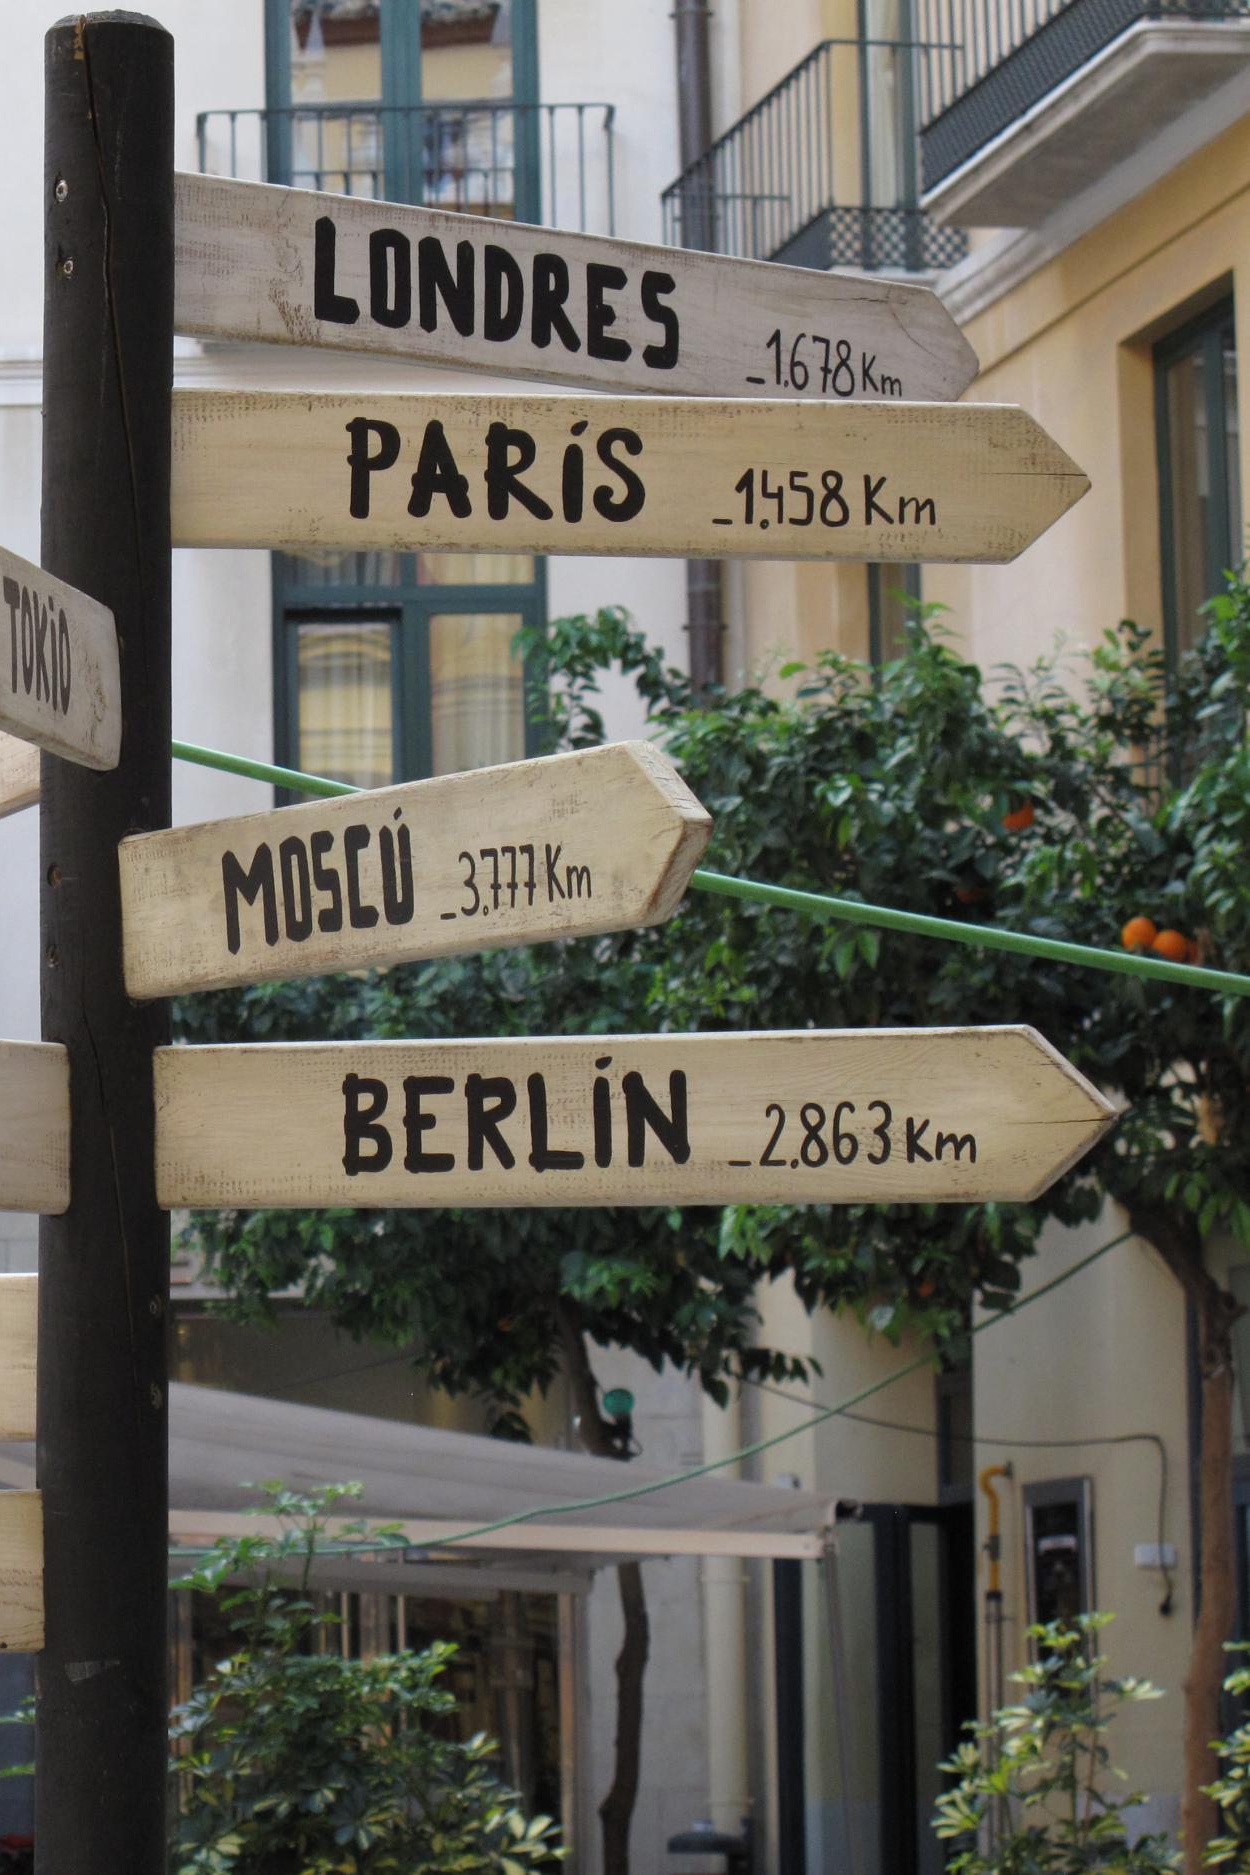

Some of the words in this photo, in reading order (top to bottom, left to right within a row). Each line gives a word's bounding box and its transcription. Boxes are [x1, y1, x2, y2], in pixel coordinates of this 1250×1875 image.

[313, 215, 680, 370] LONDRES
[862, 473, 937, 527] Km
[221, 806, 415, 955] MOSCÚ
[341, 1055, 691, 1177] BERLÍN
[904, 1115, 977, 1166] Km
